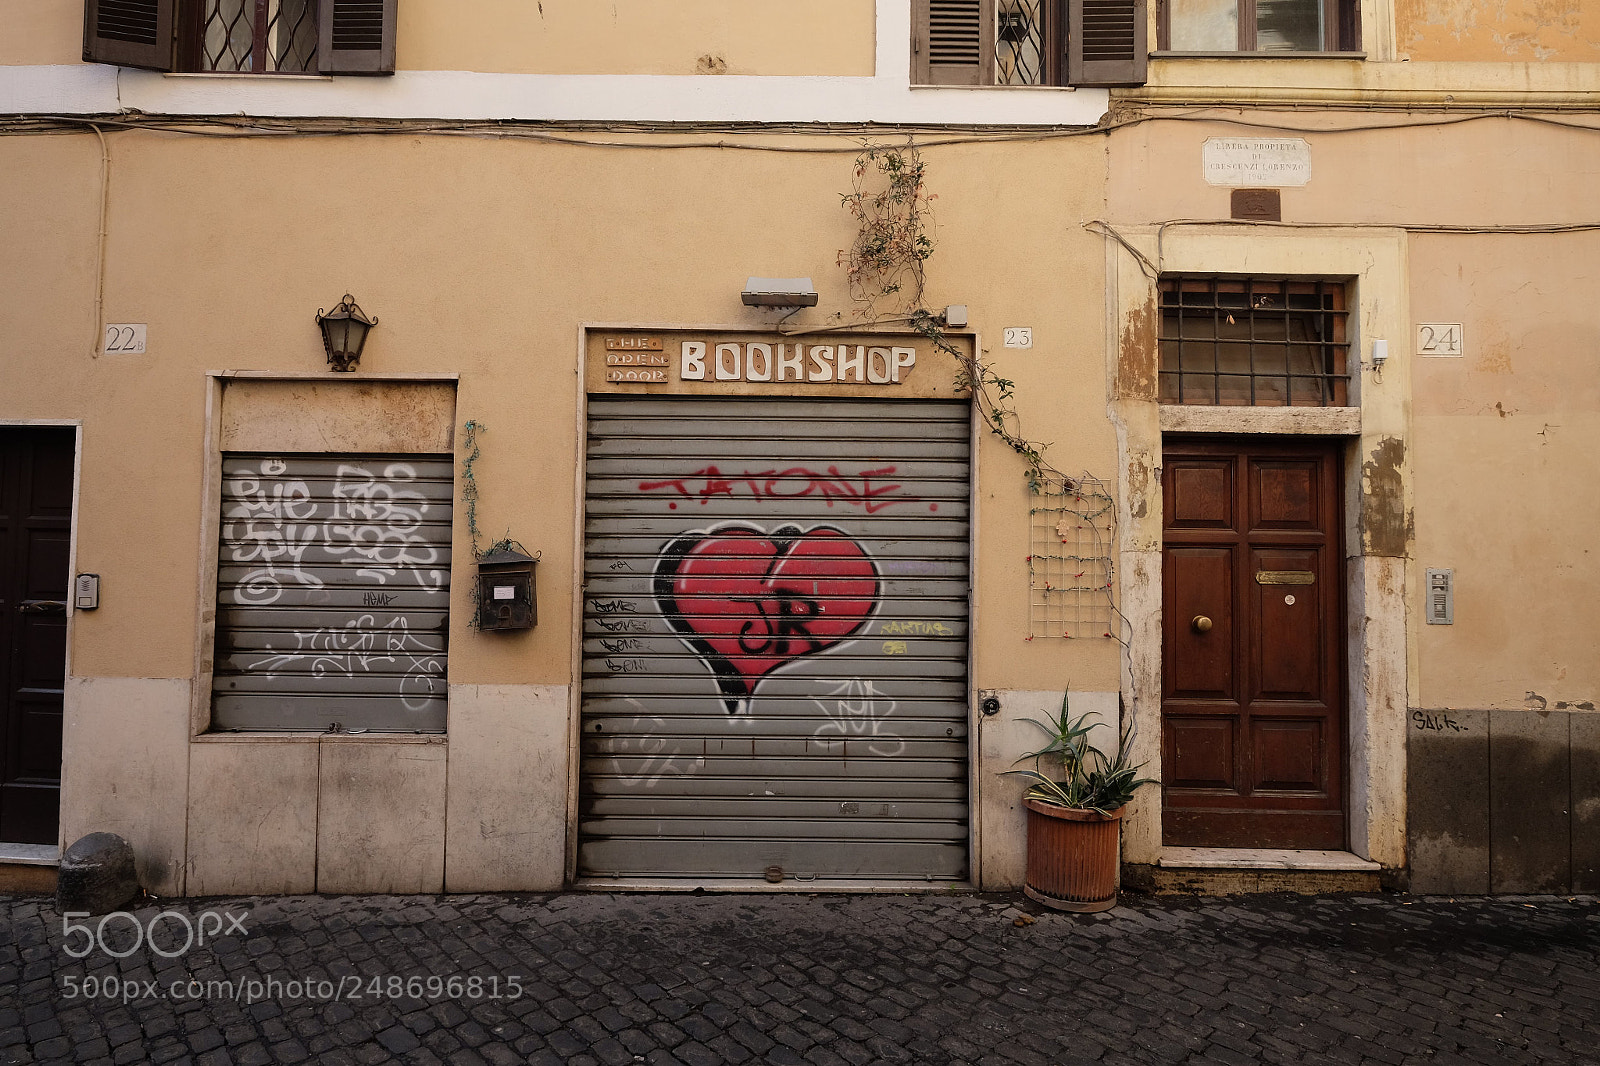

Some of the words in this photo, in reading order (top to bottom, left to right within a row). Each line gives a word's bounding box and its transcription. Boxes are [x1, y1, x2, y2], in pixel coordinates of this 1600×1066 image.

[606, 338, 649, 349] THE
[1006, 330, 1029, 345] 23
[1420, 326, 1458, 351] 24
[607, 354, 665, 365] OPEN
[681, 341, 916, 383] BOOKSHOP
[612, 370, 665, 381] DOOR
